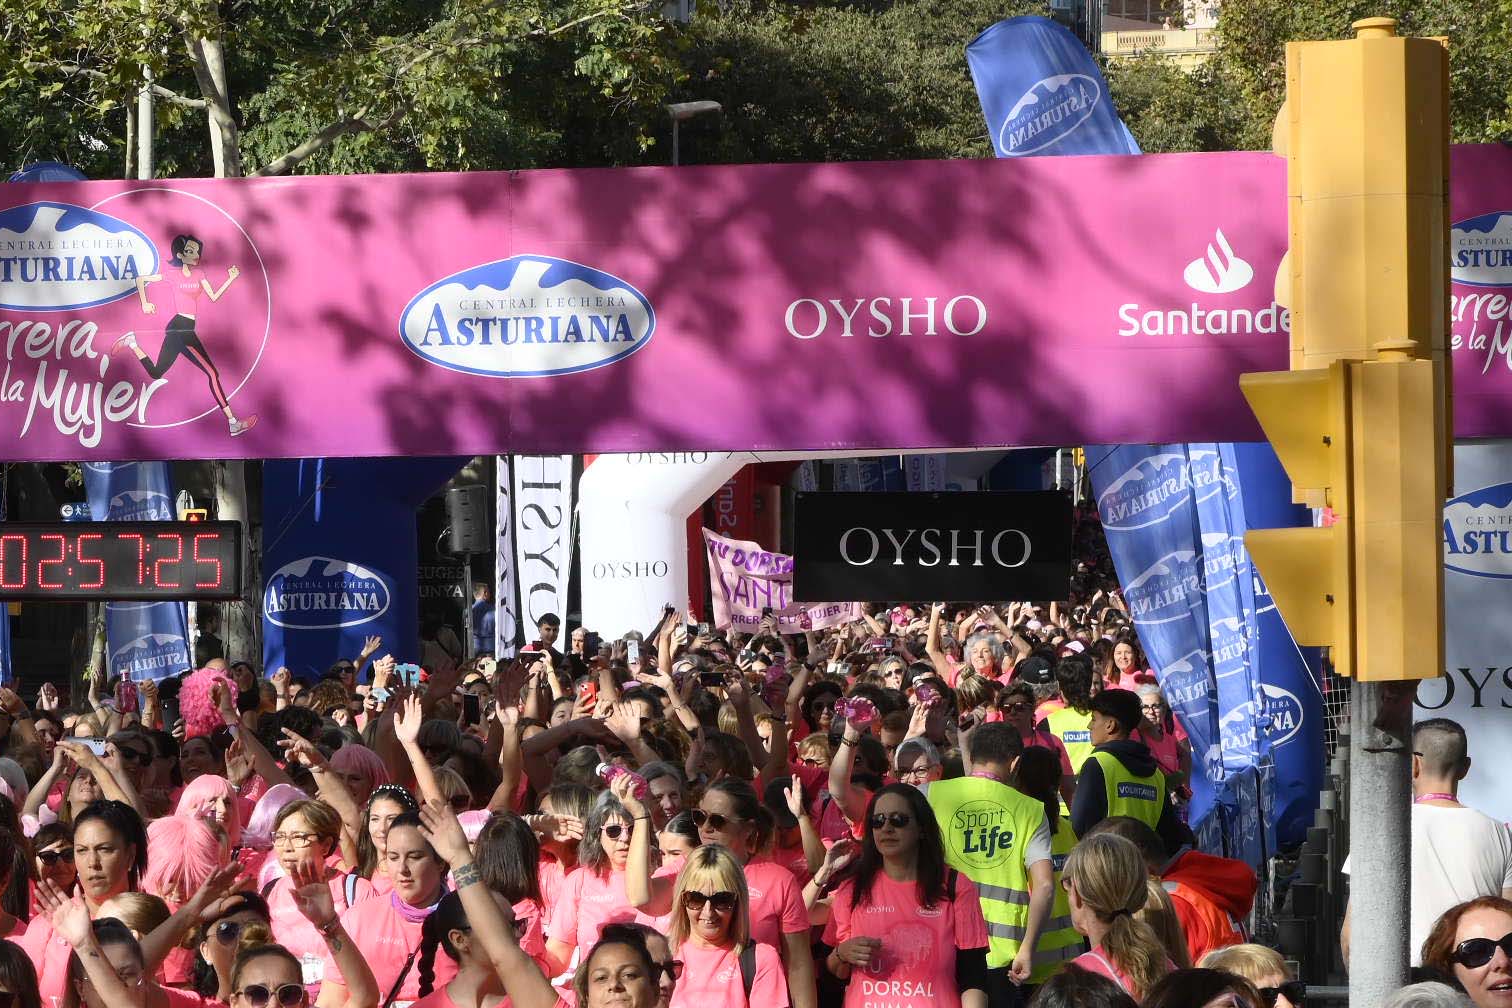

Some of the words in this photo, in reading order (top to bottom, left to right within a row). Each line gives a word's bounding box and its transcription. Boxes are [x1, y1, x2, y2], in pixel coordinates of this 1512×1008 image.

[61, 238, 137, 250] LECHERA
[460, 296, 538, 310] CENTRAL
[546, 295, 626, 308] LECHERA
[785, 295, 987, 340] OYSHO
[419, 302, 636, 347] ASTURIANA
[1118, 302, 1291, 338] Santande
[0, 362, 25, 402] la
[19, 355, 169, 448] Mujer
[0, 534, 221, 588] 02:57:25
[839, 526, 1032, 568] OYSHO
[592, 560, 669, 580] OYSHO
[267, 586, 381, 614] ASTURIANA
[955, 808, 1005, 831] Sport
[963, 826, 1013, 858] Life
[862, 980, 934, 998] DORSAL
